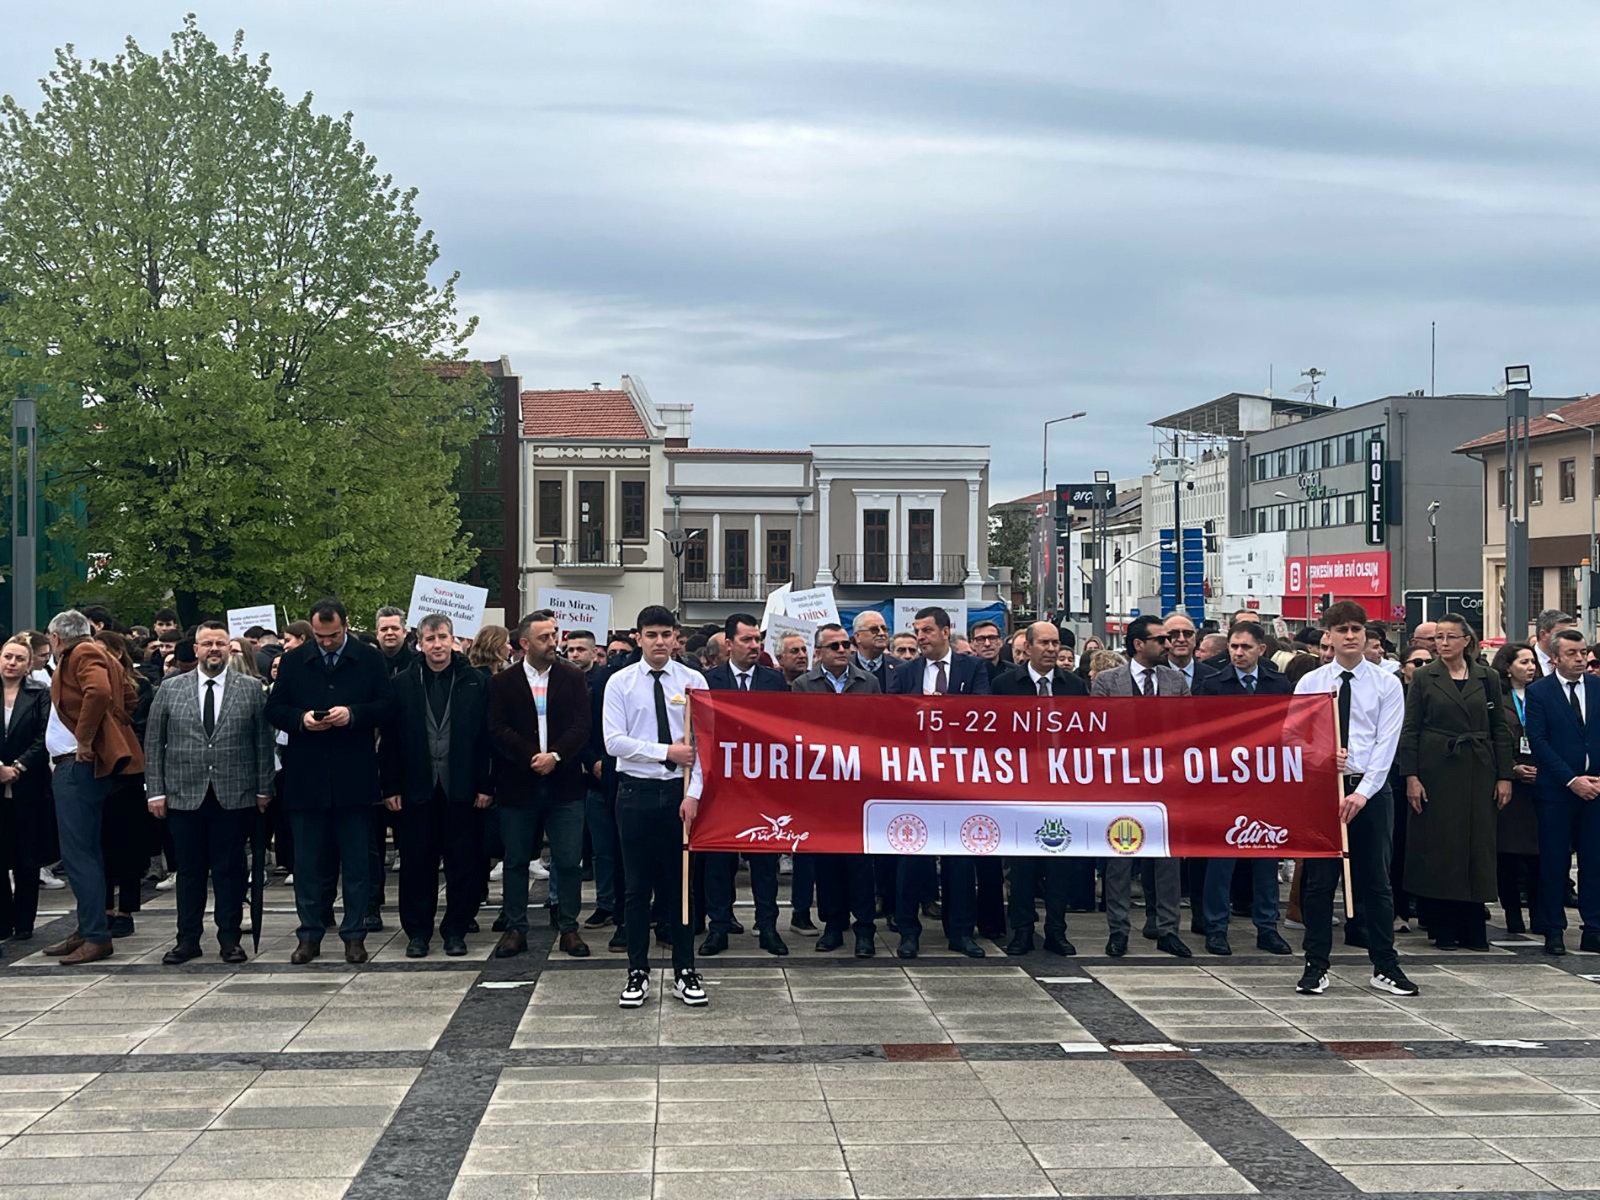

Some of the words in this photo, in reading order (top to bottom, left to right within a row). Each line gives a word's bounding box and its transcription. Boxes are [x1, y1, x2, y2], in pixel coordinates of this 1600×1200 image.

[1073, 489, 1112, 504] arçk
[1371, 442, 1381, 542] HOTEL
[1334, 560, 1344, 577] BİR
[1345, 559, 1355, 577] EVİ
[1355, 562, 1379, 577] OLSUN
[549, 597, 566, 608] Bin
[553, 610, 567, 620] Bir
[569, 612, 594, 623] Şehir
[916, 709, 997, 732] 15-22
[1012, 706, 1108, 732] NİSAN
[719, 735, 861, 781] TURİZM
[880, 746, 1029, 784] HAFTASI
[1049, 747, 1165, 784] KUTLU
[1183, 746, 1304, 784] OLSUN
[735, 826, 810, 852] Türkiye
[1225, 815, 1289, 845] Edirne
